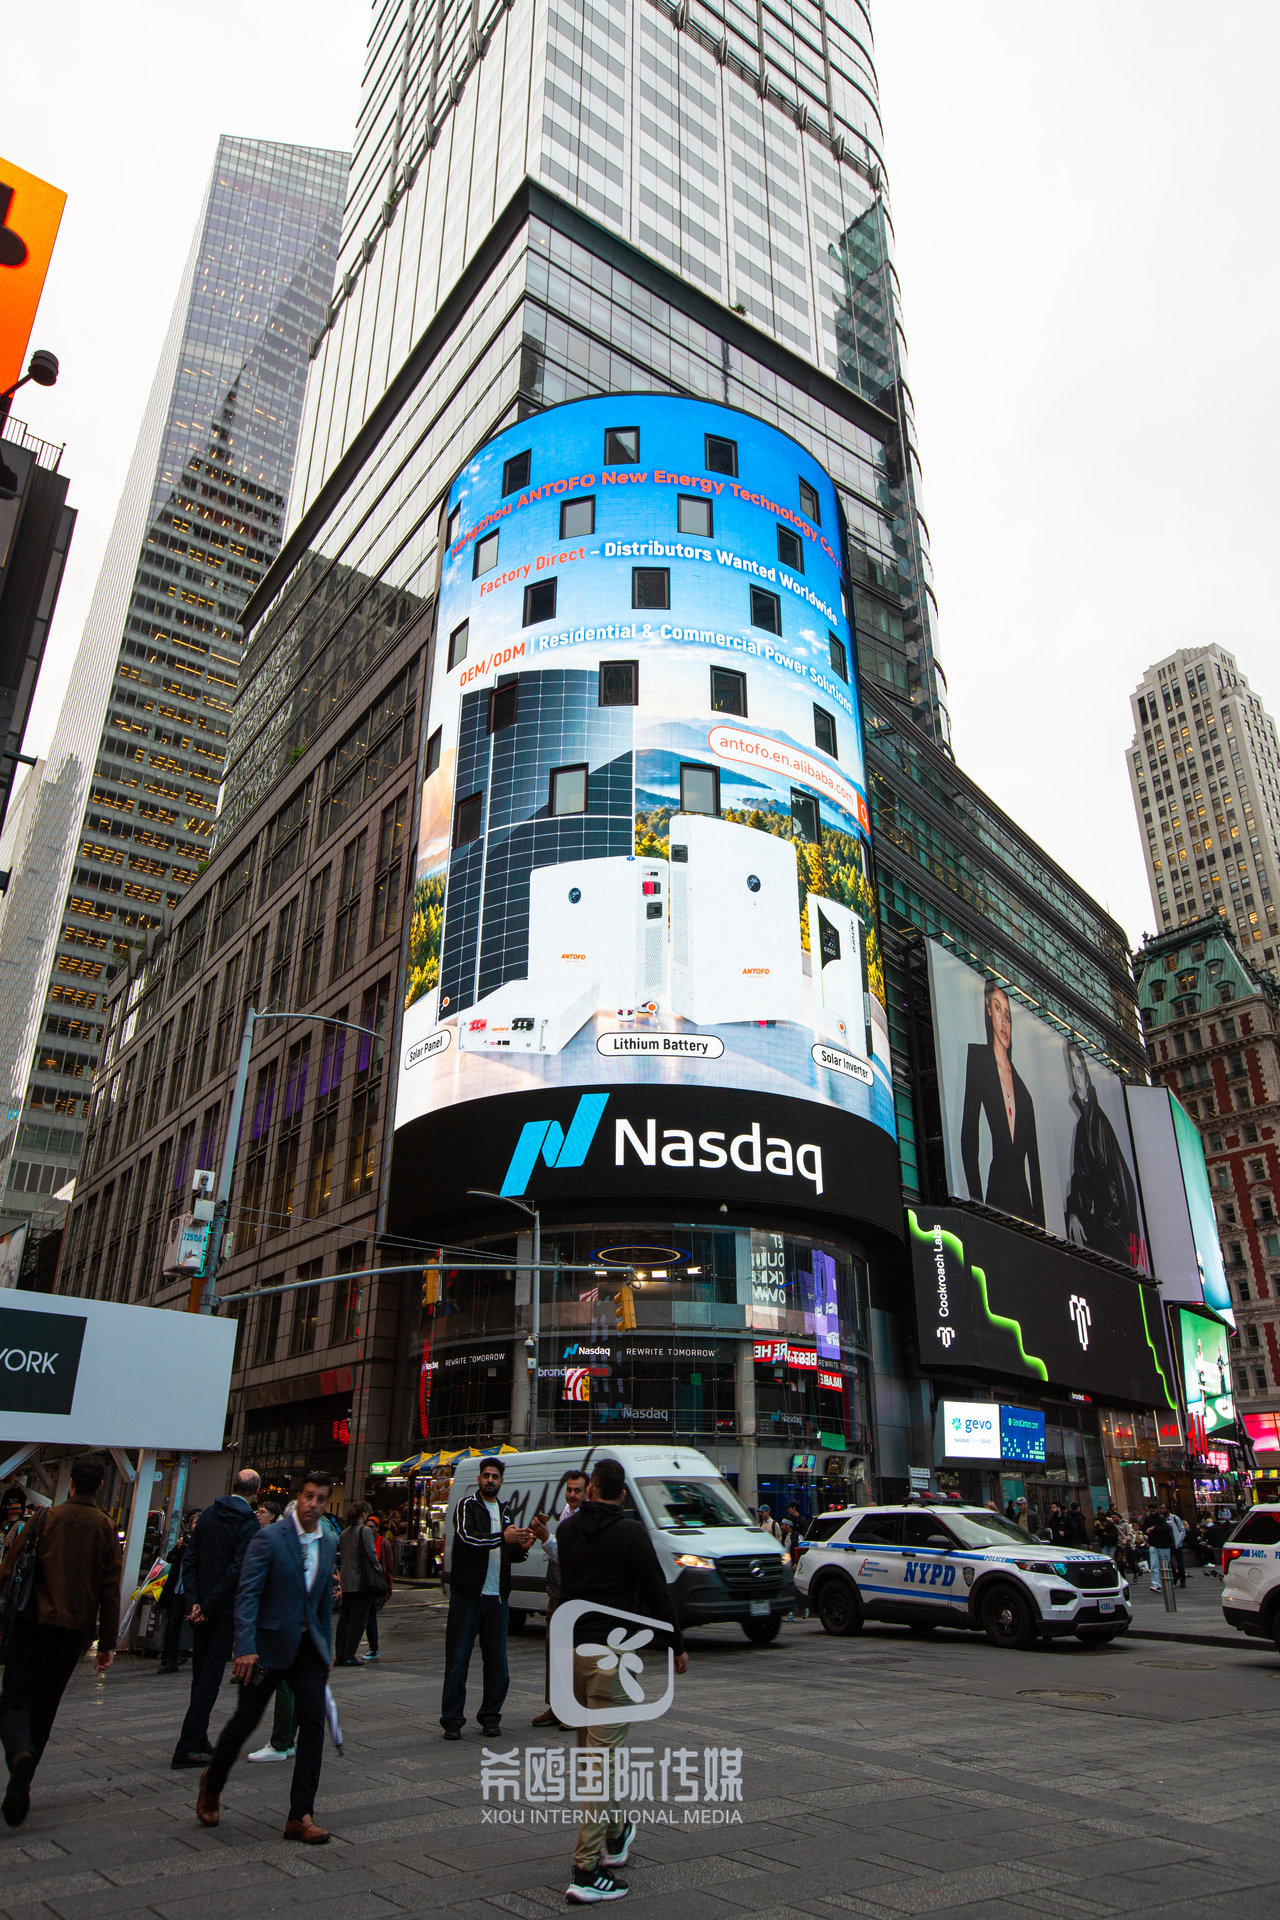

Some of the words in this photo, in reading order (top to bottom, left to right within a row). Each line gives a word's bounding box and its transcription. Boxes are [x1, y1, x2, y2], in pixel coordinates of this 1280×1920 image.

[451, 503, 512, 560] Hangzhou
[516, 474, 595, 509] ANTOFO
[601, 471, 648, 485] New
[654, 470, 724, 495] Energy
[730, 482, 818, 542] Technology
[480, 563, 531, 598] Factory
[535, 546, 585, 571] Direct
[604, 540, 712, 562] Distributors
[715, 548, 776, 582] Wanted
[779, 570, 838, 626] Worldwide
[459, 641, 526, 687] OEM/ODM
[539, 623, 636, 651] Residential
[642, 623, 654, 638] &
[660, 624, 761, 657] Commercial
[764, 645, 808, 677] Power
[809, 666, 853, 715] Solutions
[719, 736, 854, 806] antofo.en.alibaba.com
[409, 1044, 424, 1063] Solar
[424, 1035, 443, 1054] Panel
[613, 1038, 660, 1050] Lithium
[663, 1039, 709, 1054] Battery
[821, 1050, 841, 1067] Solar
[843, 1059, 868, 1079] Inverter
[615, 1118, 824, 1196] Nasdaq
[183, 1232, 203, 1243] 726156
[933, 1224, 943, 1252] Labs
[934, 1254, 949, 1318] Cockroach
[445, 1356, 467, 1367] REWRITE
[469, 1353, 505, 1364] TOMORROW
[578, 1347, 611, 1357] Nasdaq
[626, 1348, 664, 1356] REWRITE
[668, 1348, 715, 1357] TOMORROW
[623, 1407, 669, 1421] Nasdaq
[782, 1414, 803, 1426] Nasdaq
[965, 1419, 993, 1433] gevo
[983, 1555, 1007, 1563] POLICE
[903, 1561, 956, 1587] NYPD
